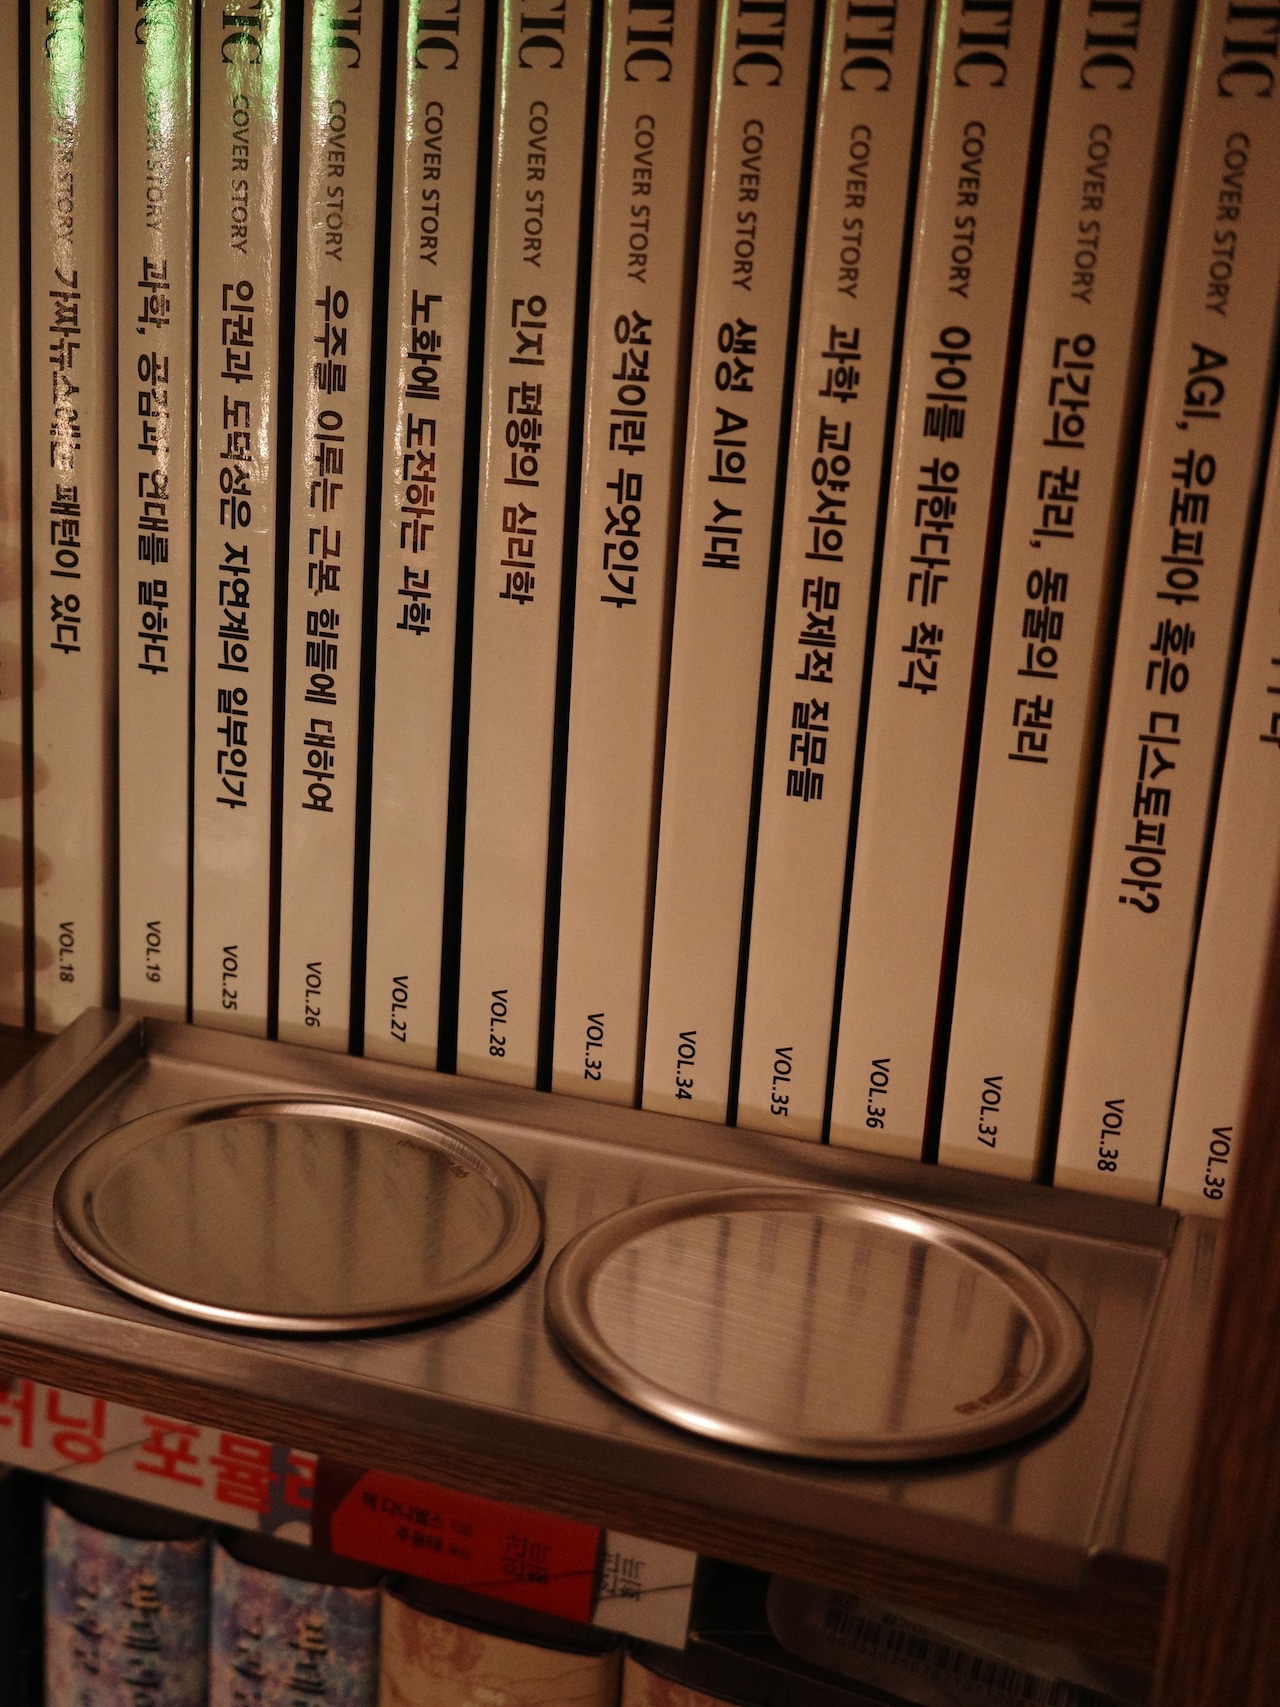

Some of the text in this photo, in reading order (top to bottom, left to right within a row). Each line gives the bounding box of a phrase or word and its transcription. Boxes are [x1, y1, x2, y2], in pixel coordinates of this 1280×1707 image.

[230, 94, 250, 255] COVER STORY
[325, 99, 348, 262] COVER STORY
[419, 100, 444, 266] COVER STORY
[523, 100, 549, 268] COVER STORY
[627, 114, 656, 284] COVER STORY
[732, 118, 765, 292] COVER STORY
[838, 124, 873, 299] COVER STORY
[948, 120, 987, 299] COVER STORY
[1071, 123, 1113, 305] COVER STORY
[1205, 131, 1251, 317] COVER STORY
[135, 256, 170, 675] 과학, 공감과 연대를 말하다
[396, 289, 443, 636] 노화에 도전하는 과학
[498, 294, 547, 606] 인지 편향의 심리학
[600, 310, 653, 609] 성격이란 무엇인가
[702, 317, 758, 570] 생성 AI의 시대
[898, 326, 972, 695] 아이를 위한다는 착각
[49, 484, 81, 579] 패턴이
[216, 280, 255, 809] 인권과 도덕성은 자연계의 일부인가
[301, 285, 349, 813] 우주를 이루는 근본 힘들에 대하여
[786, 324, 862, 803] 과학 교양서의 문제적 질문들
[1008, 333, 1097, 764] 인간의 권리, 동물의 권리
[50, 593, 81, 655] 있다
[1118, 342, 1229, 914] AGI, 유토피아 혹은 디스토피아?
[58, 921, 75, 983] VOL.18
[145, 920, 161, 983] VOL.19
[221, 945, 238, 1010] VOL.25
[304, 961, 322, 1028] VOL.26
[390, 975, 409, 1043] VOL.27
[488, 989, 508, 1058] VOL.28
[583, 1012, 605, 1082] VOL.32
[674, 1030, 697, 1100] VOL.34
[770, 1046, 794, 1118] VOL.35
[865, 1058, 891, 1129] VOL.36
[977, 1075, 1003, 1148] VOL.37
[1096, 1098, 1125, 1173] VOL.38
[1203, 1126, 1233, 1201] VOL.39
